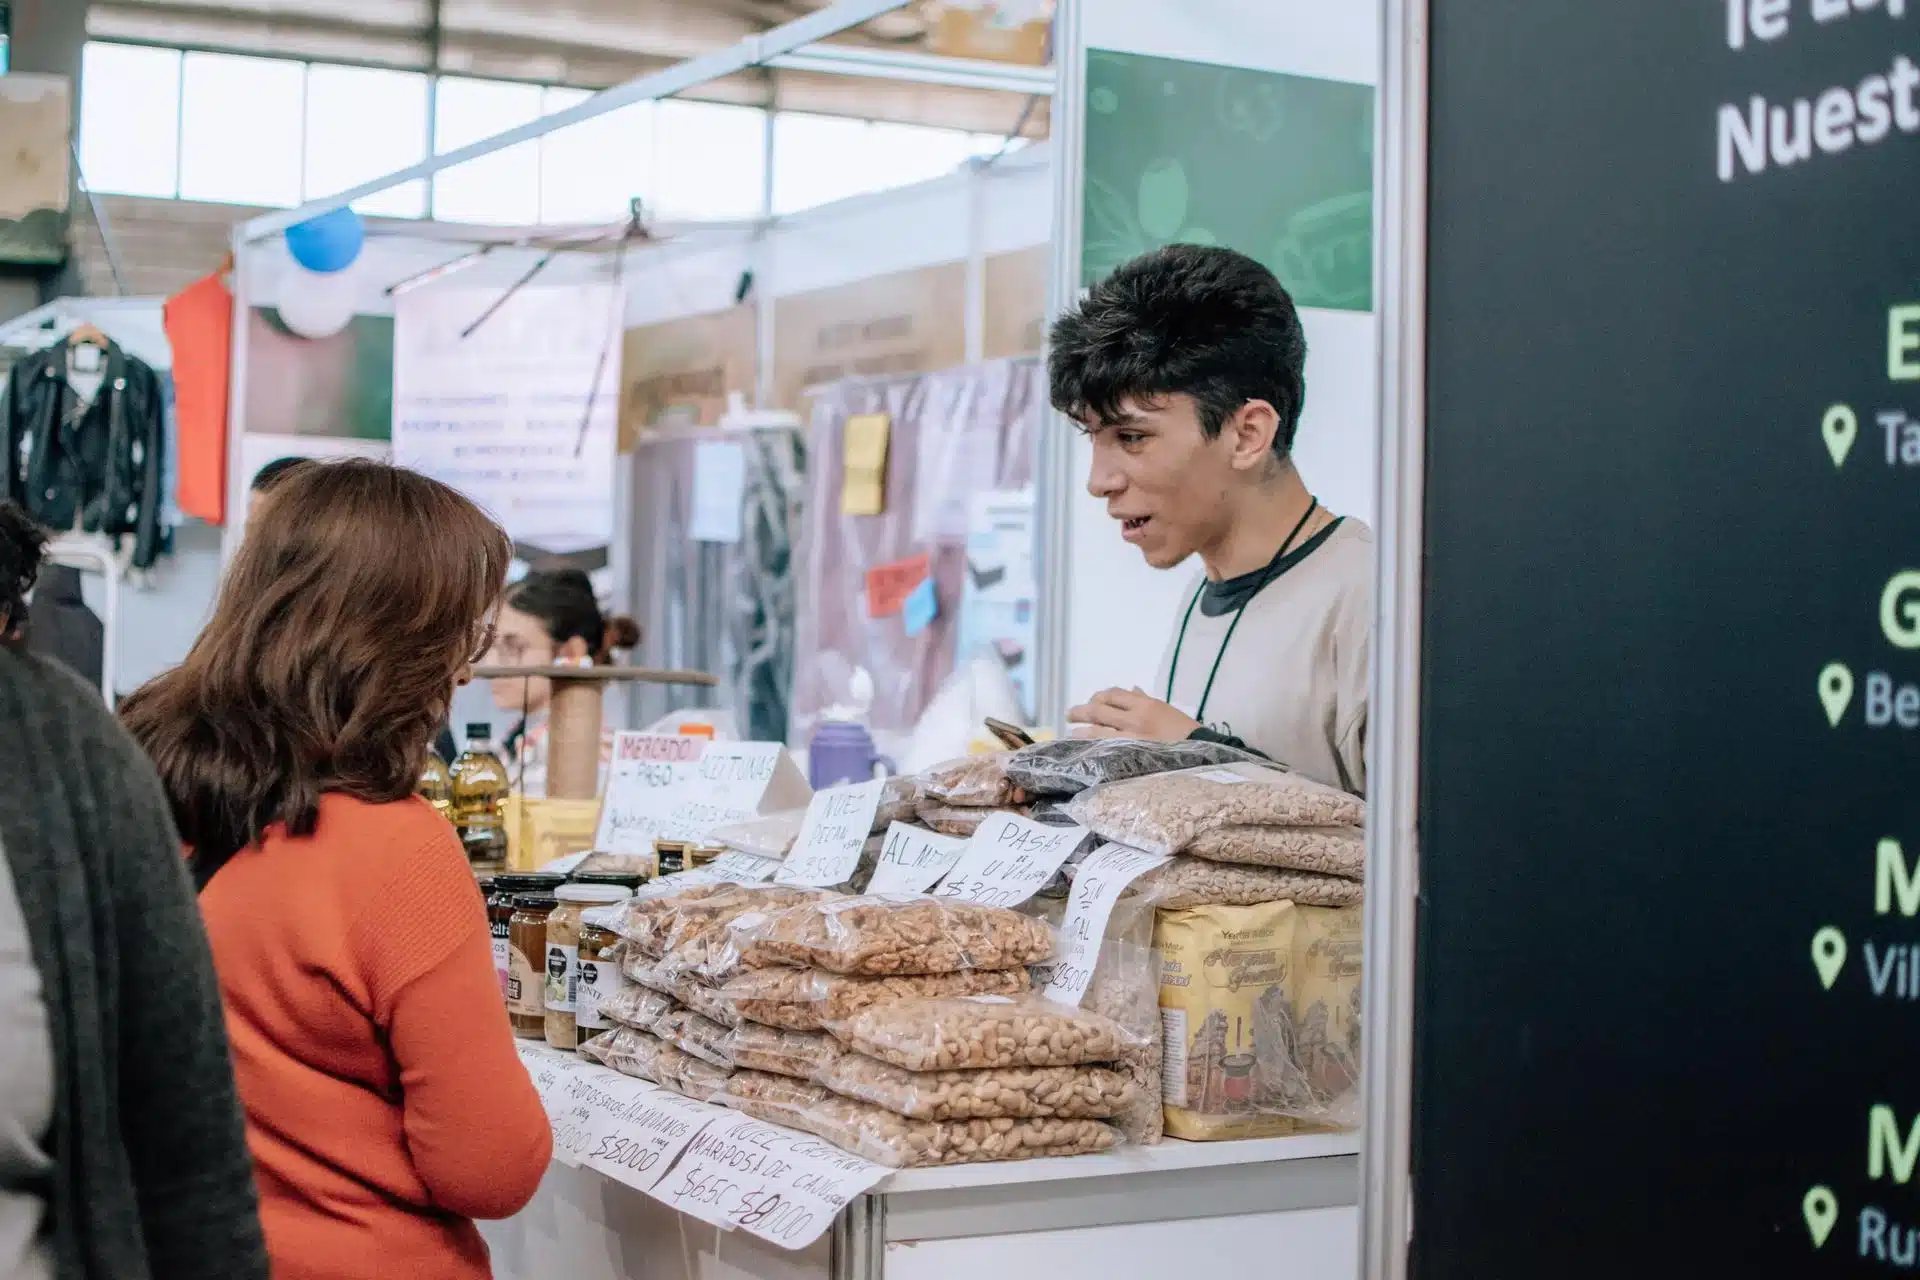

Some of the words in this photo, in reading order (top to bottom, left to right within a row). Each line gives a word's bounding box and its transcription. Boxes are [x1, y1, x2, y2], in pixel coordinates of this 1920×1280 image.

[1716, 54, 1920, 183] Nuest
[1865, 671, 1920, 730] Be
[998, 822, 1069, 853] PASAS
[725, 1121, 792, 1152] NUEZ
[1858, 1205, 1920, 1269] Ru
